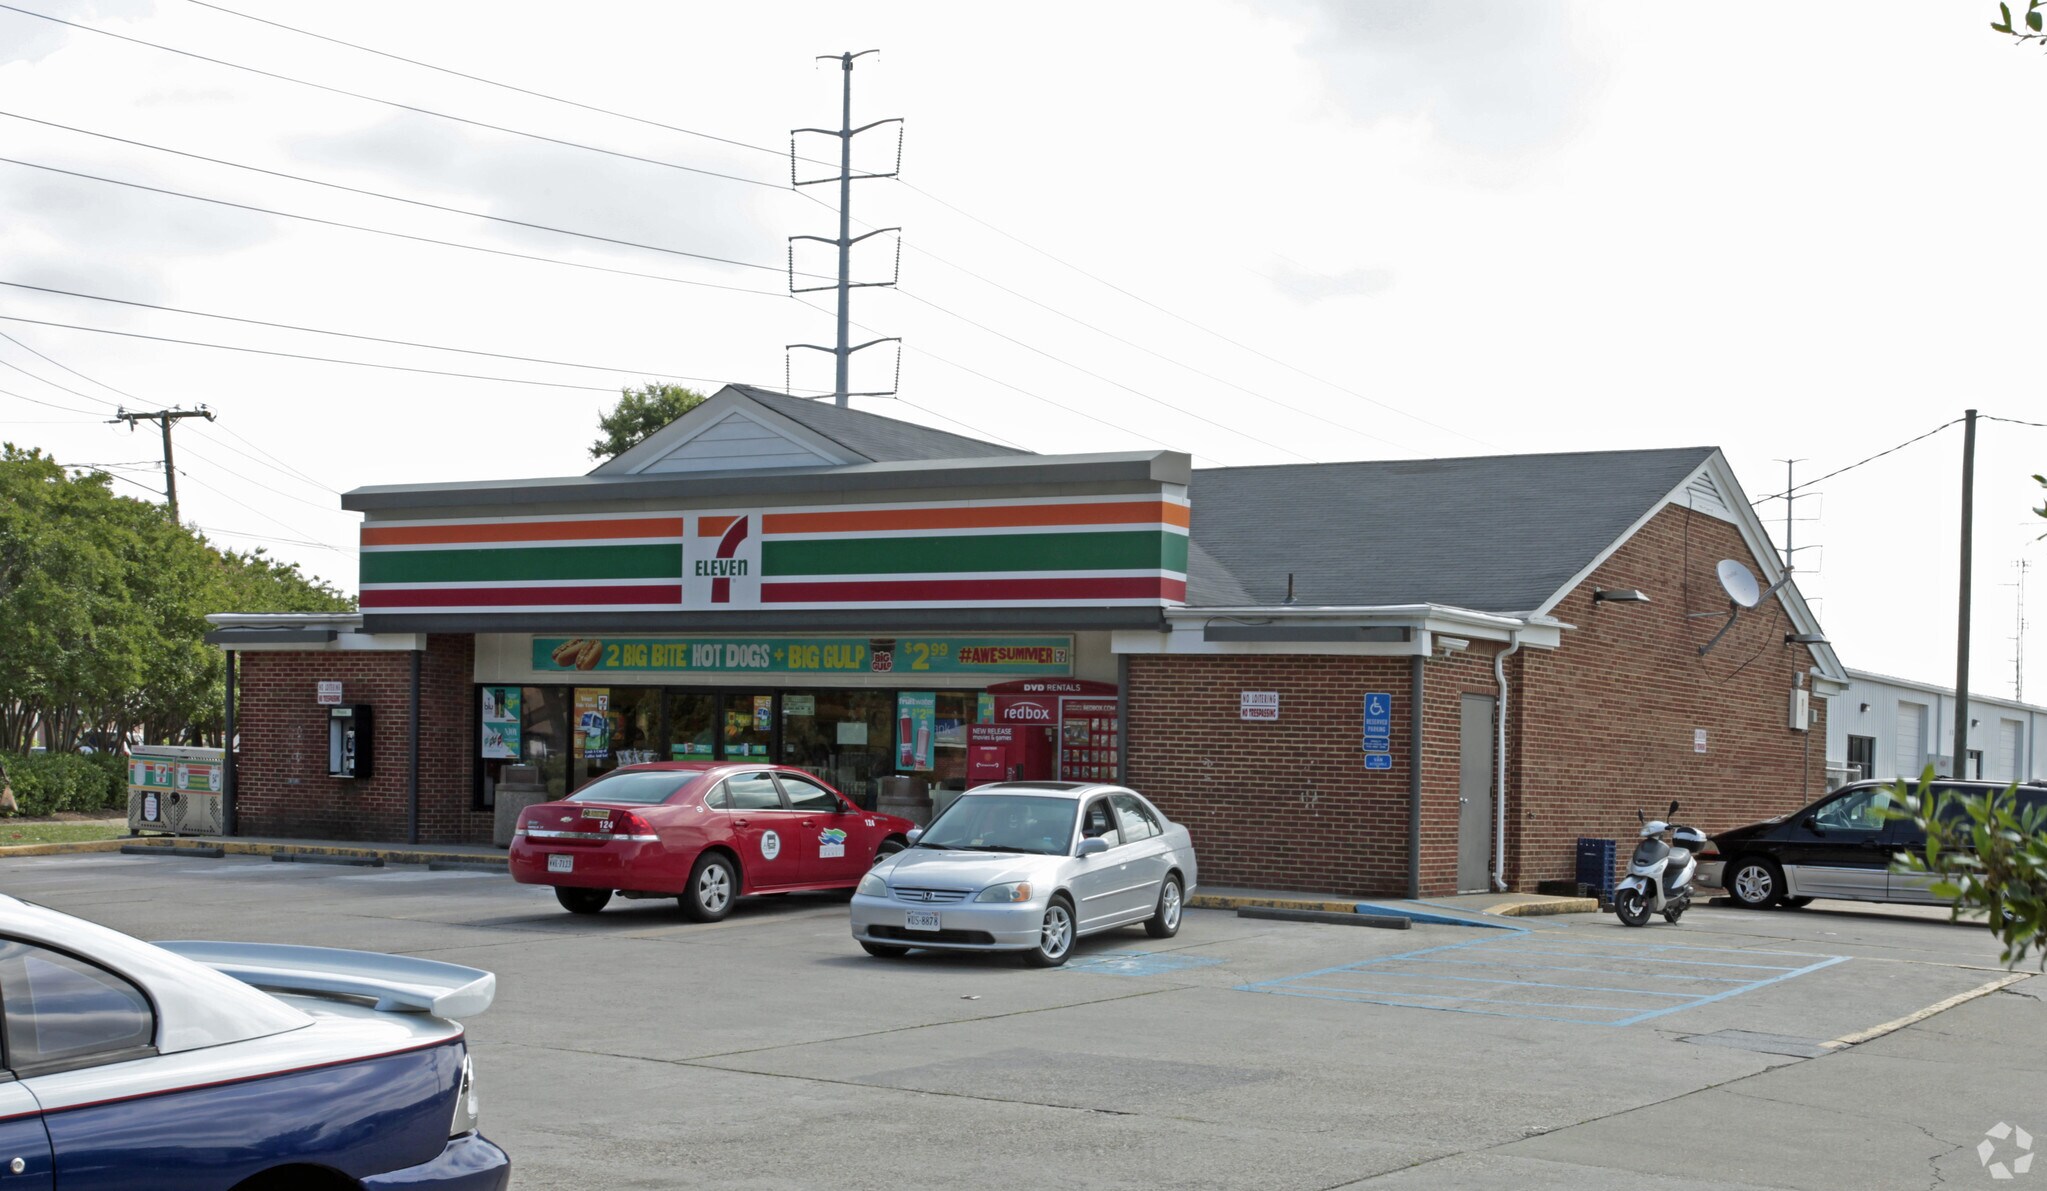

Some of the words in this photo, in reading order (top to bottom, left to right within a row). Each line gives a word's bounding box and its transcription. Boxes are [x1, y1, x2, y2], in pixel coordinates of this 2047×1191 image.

[606, 644, 620, 667] 2
[623, 644, 647, 667] BIG
[651, 644, 687, 667] BITE
[692, 644, 722, 667] HOT
[725, 644, 770, 667] DOGS
[788, 644, 819, 669] BIG
[823, 644, 865, 669] GULP
[874, 652, 890, 661] BIG
[958, 647, 1053, 664] #AWESUMMER
[872, 661, 892, 671] GULP
[1024, 684, 1045, 692] DVD
[1046, 684, 1081, 692] RENTALS
[1242, 694, 1249, 704] NO
[1252, 694, 1276, 704] LOITERING
[1004, 706, 1049, 720] redbox
[1242, 708, 1248, 717] NO
[1249, 708, 1276, 718] TRESPASSING
[1366, 718, 1388, 726] RESERVED
[972, 727, 986, 735] NEW
[599, 820, 614, 829] 124
[864, 819, 876, 827] 124
